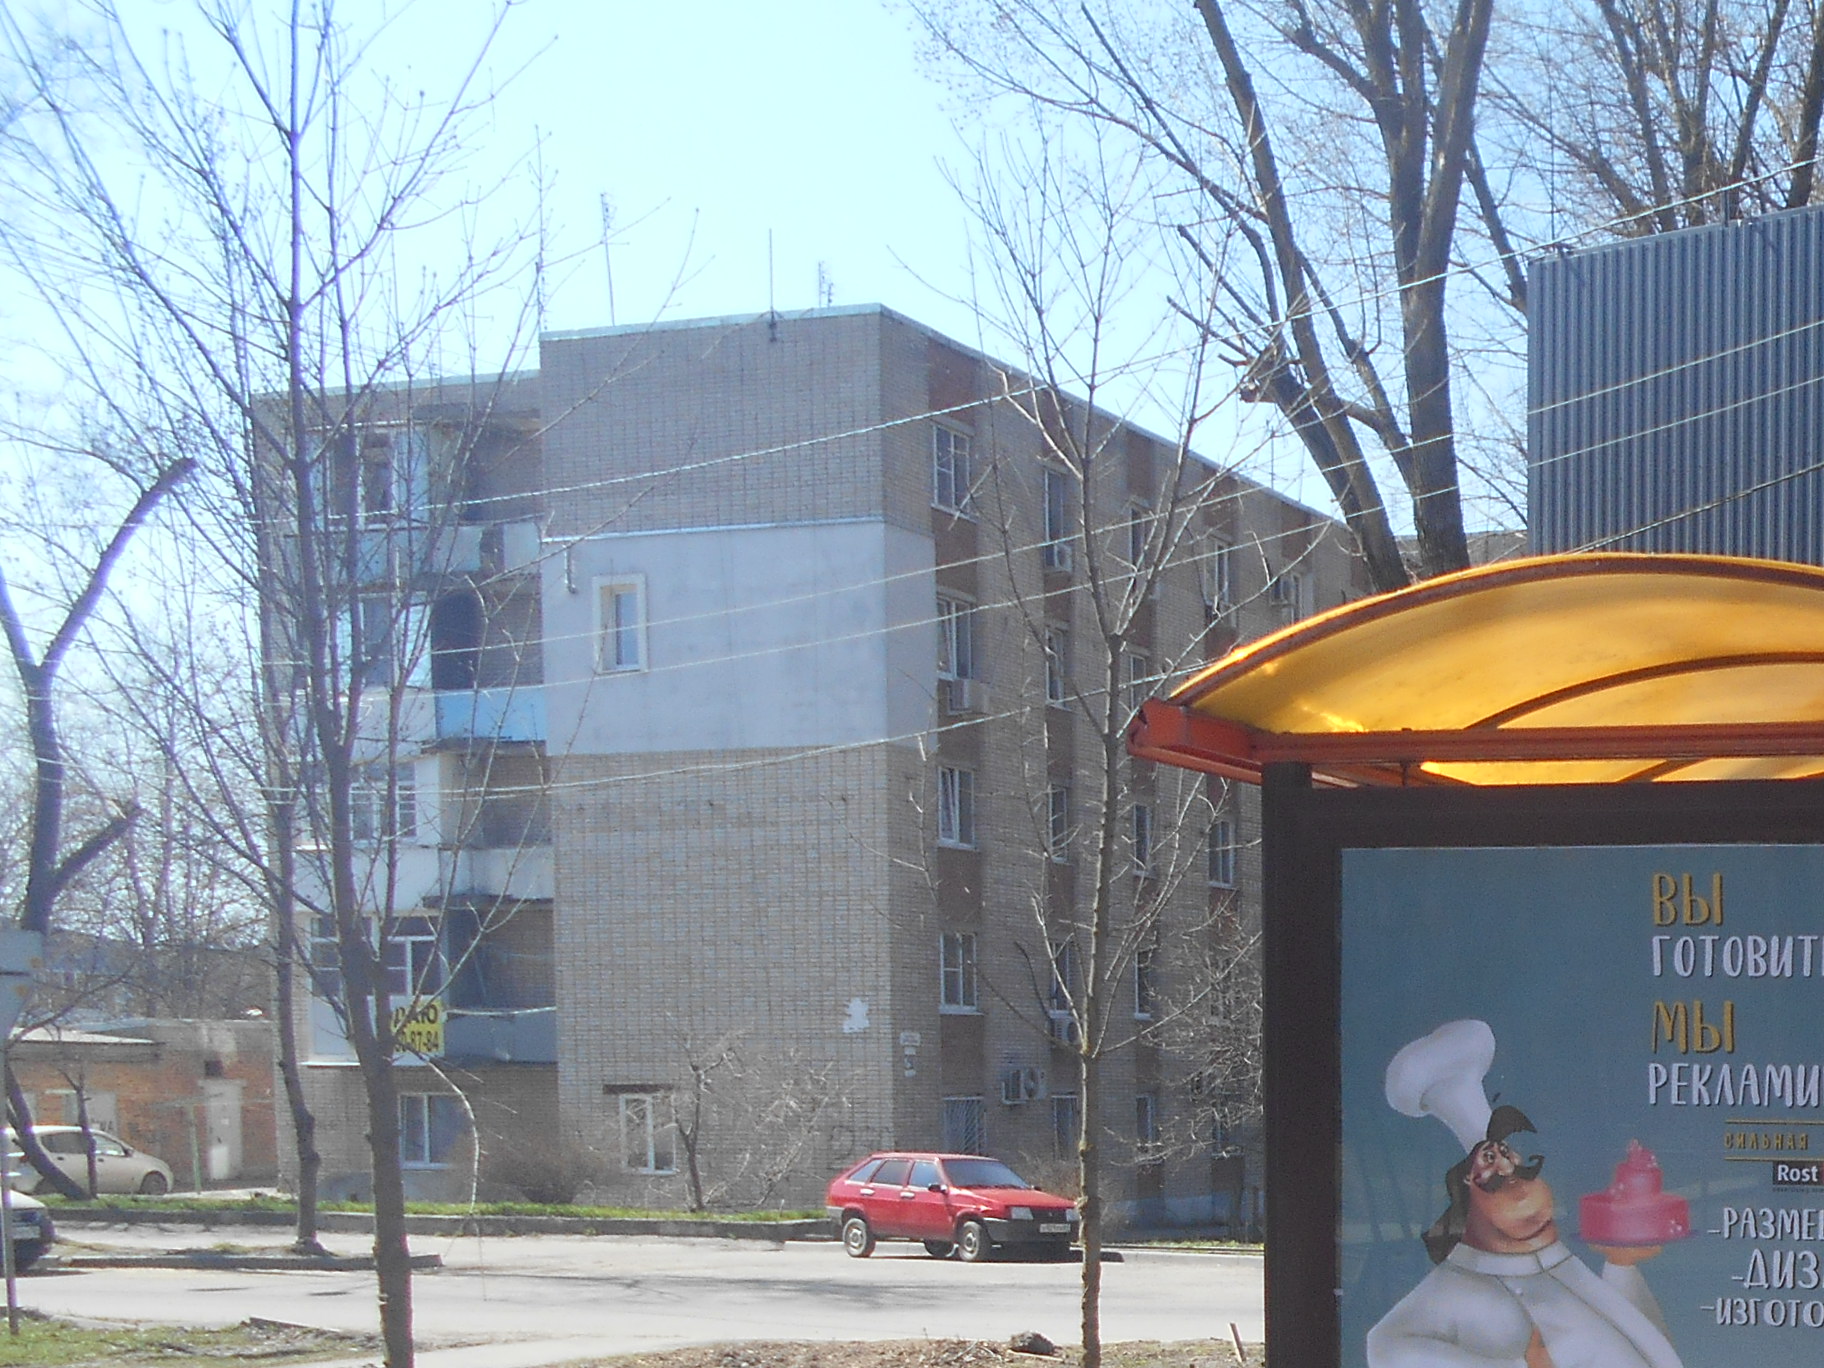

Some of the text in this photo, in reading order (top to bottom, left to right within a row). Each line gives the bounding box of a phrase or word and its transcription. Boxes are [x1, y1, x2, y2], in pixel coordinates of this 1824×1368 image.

[1652, 871, 1723, 926] ВЫ
[1653, 999, 1735, 1054] МЫ
[1724, 1132, 1809, 1150] СИЛЬНАЯ
[1777, 1164, 1819, 1182] Rost
